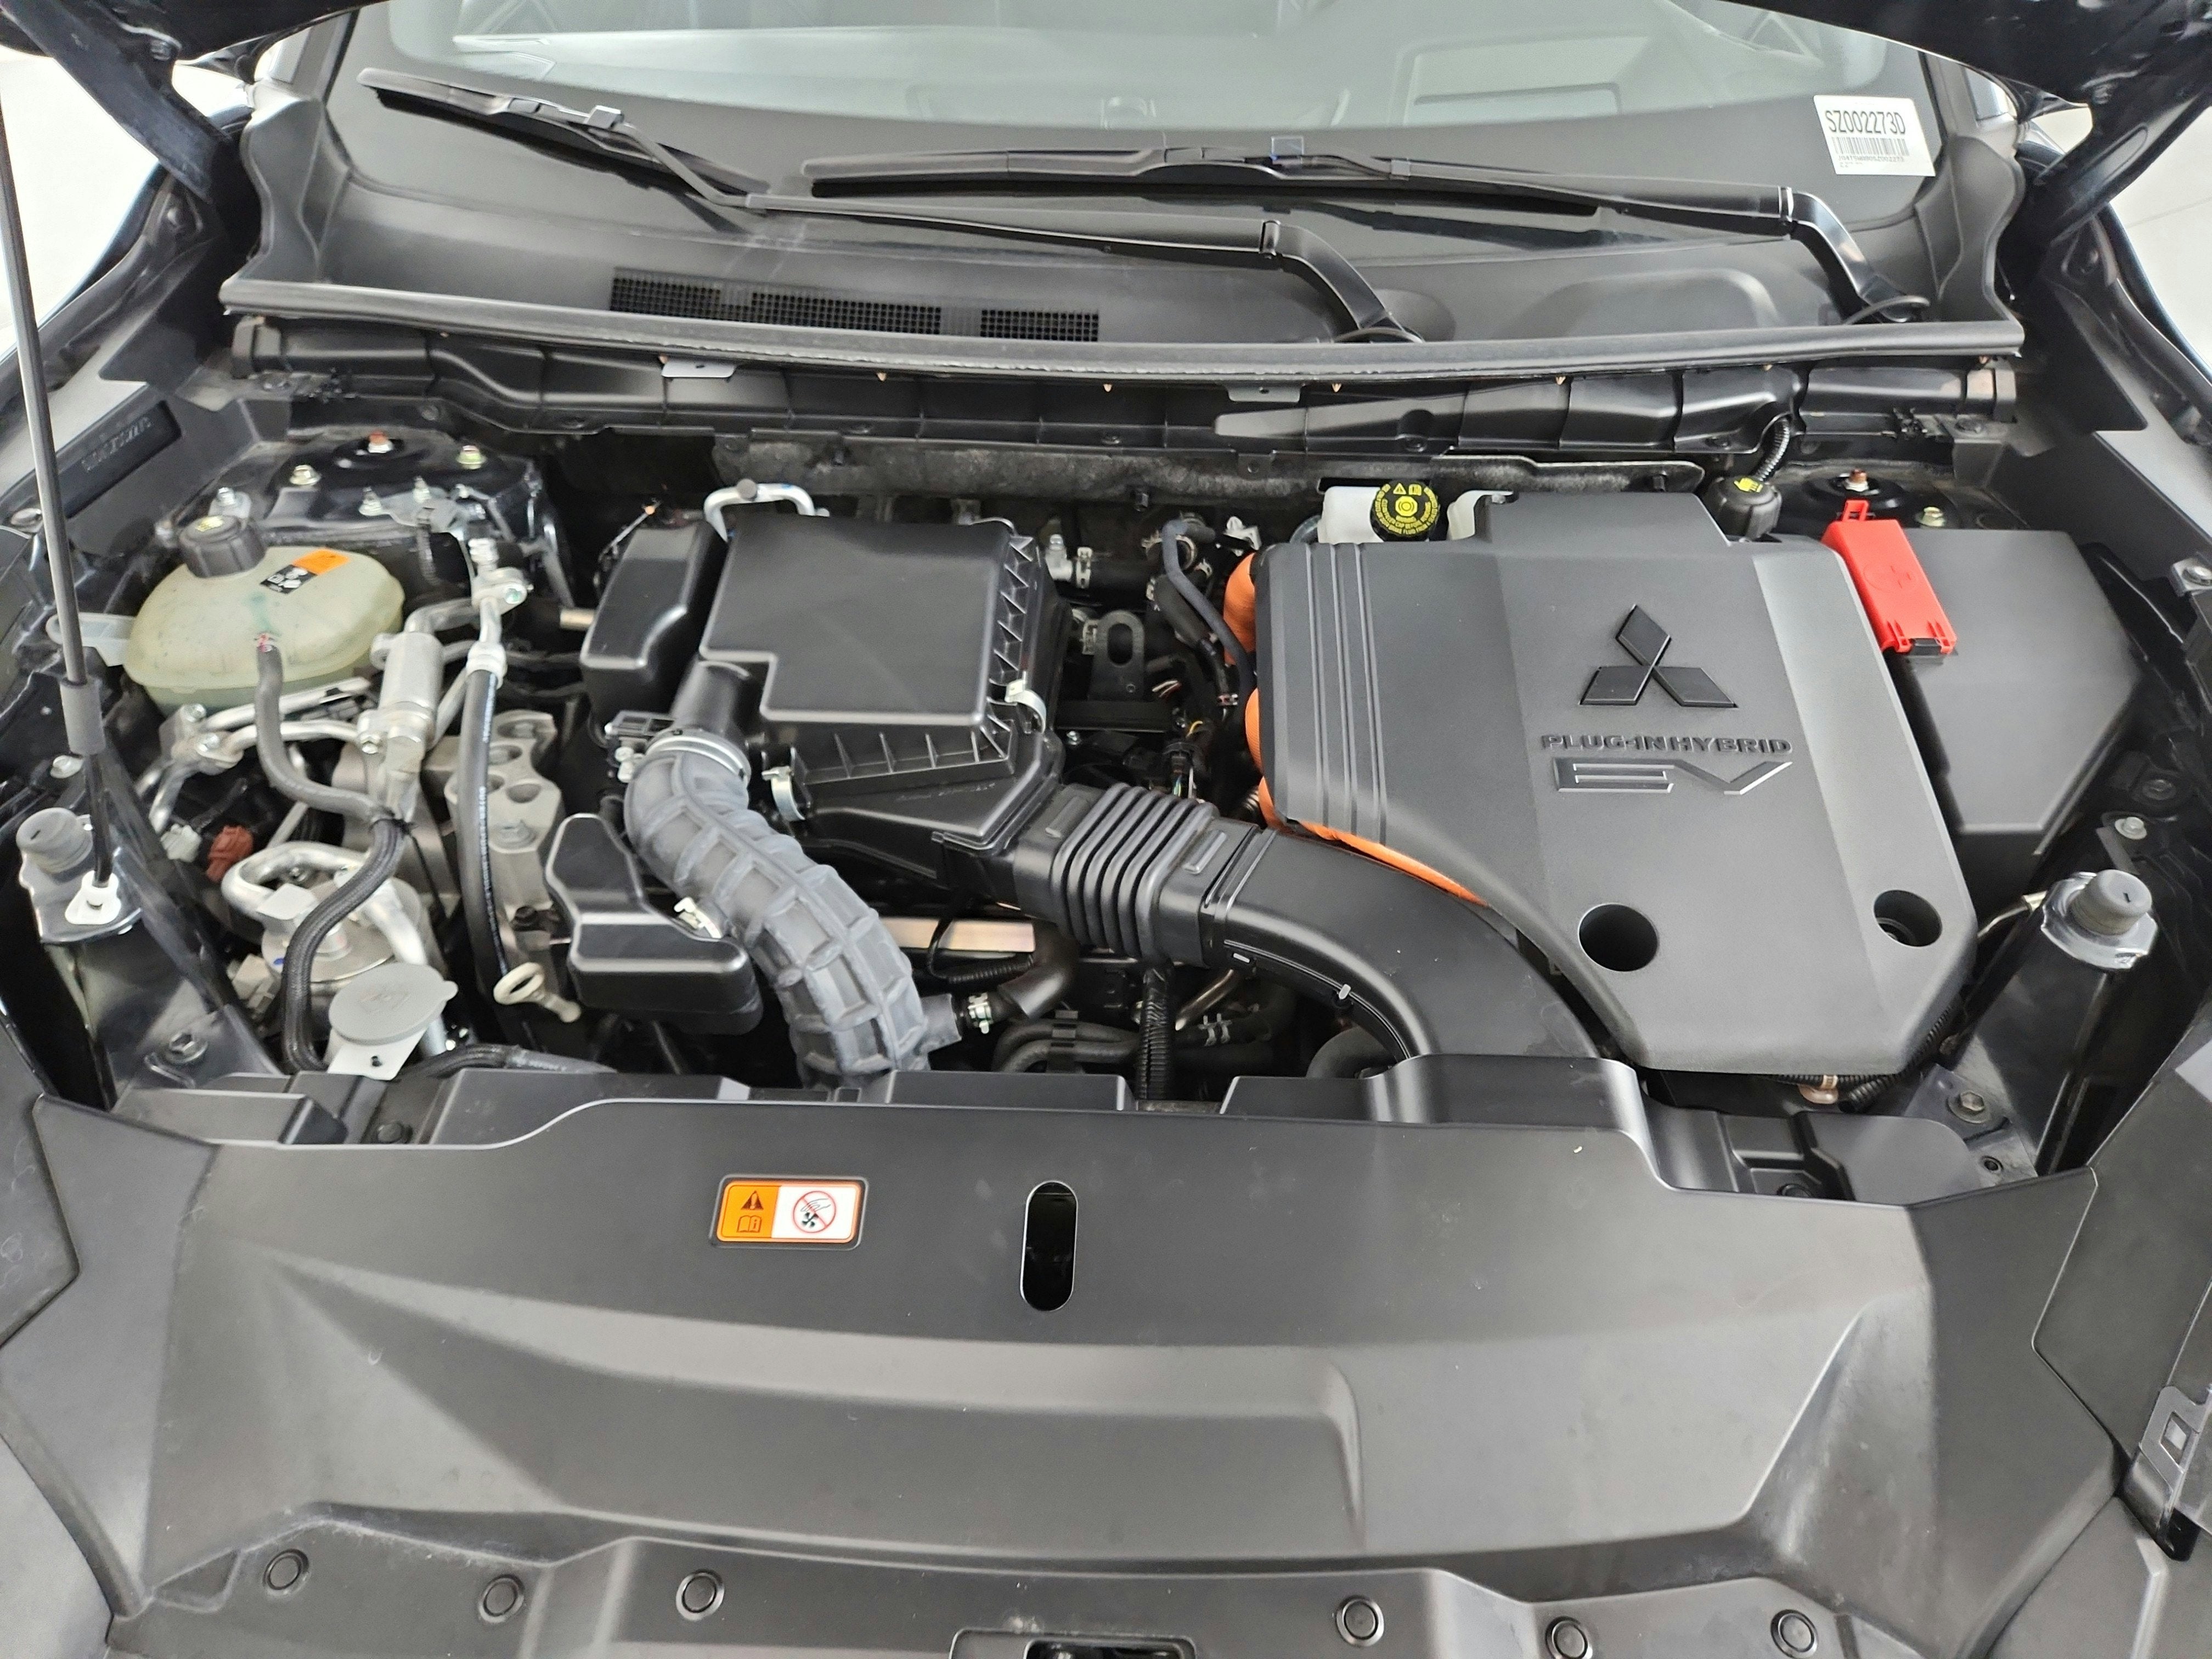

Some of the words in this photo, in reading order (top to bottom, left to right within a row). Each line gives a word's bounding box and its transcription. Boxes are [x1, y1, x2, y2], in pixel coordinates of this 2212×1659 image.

[1541, 734, 1668, 752] PLUG-IN
[1669, 736, 1792, 754] HYBRID
[1554, 757, 1793, 795] EV
